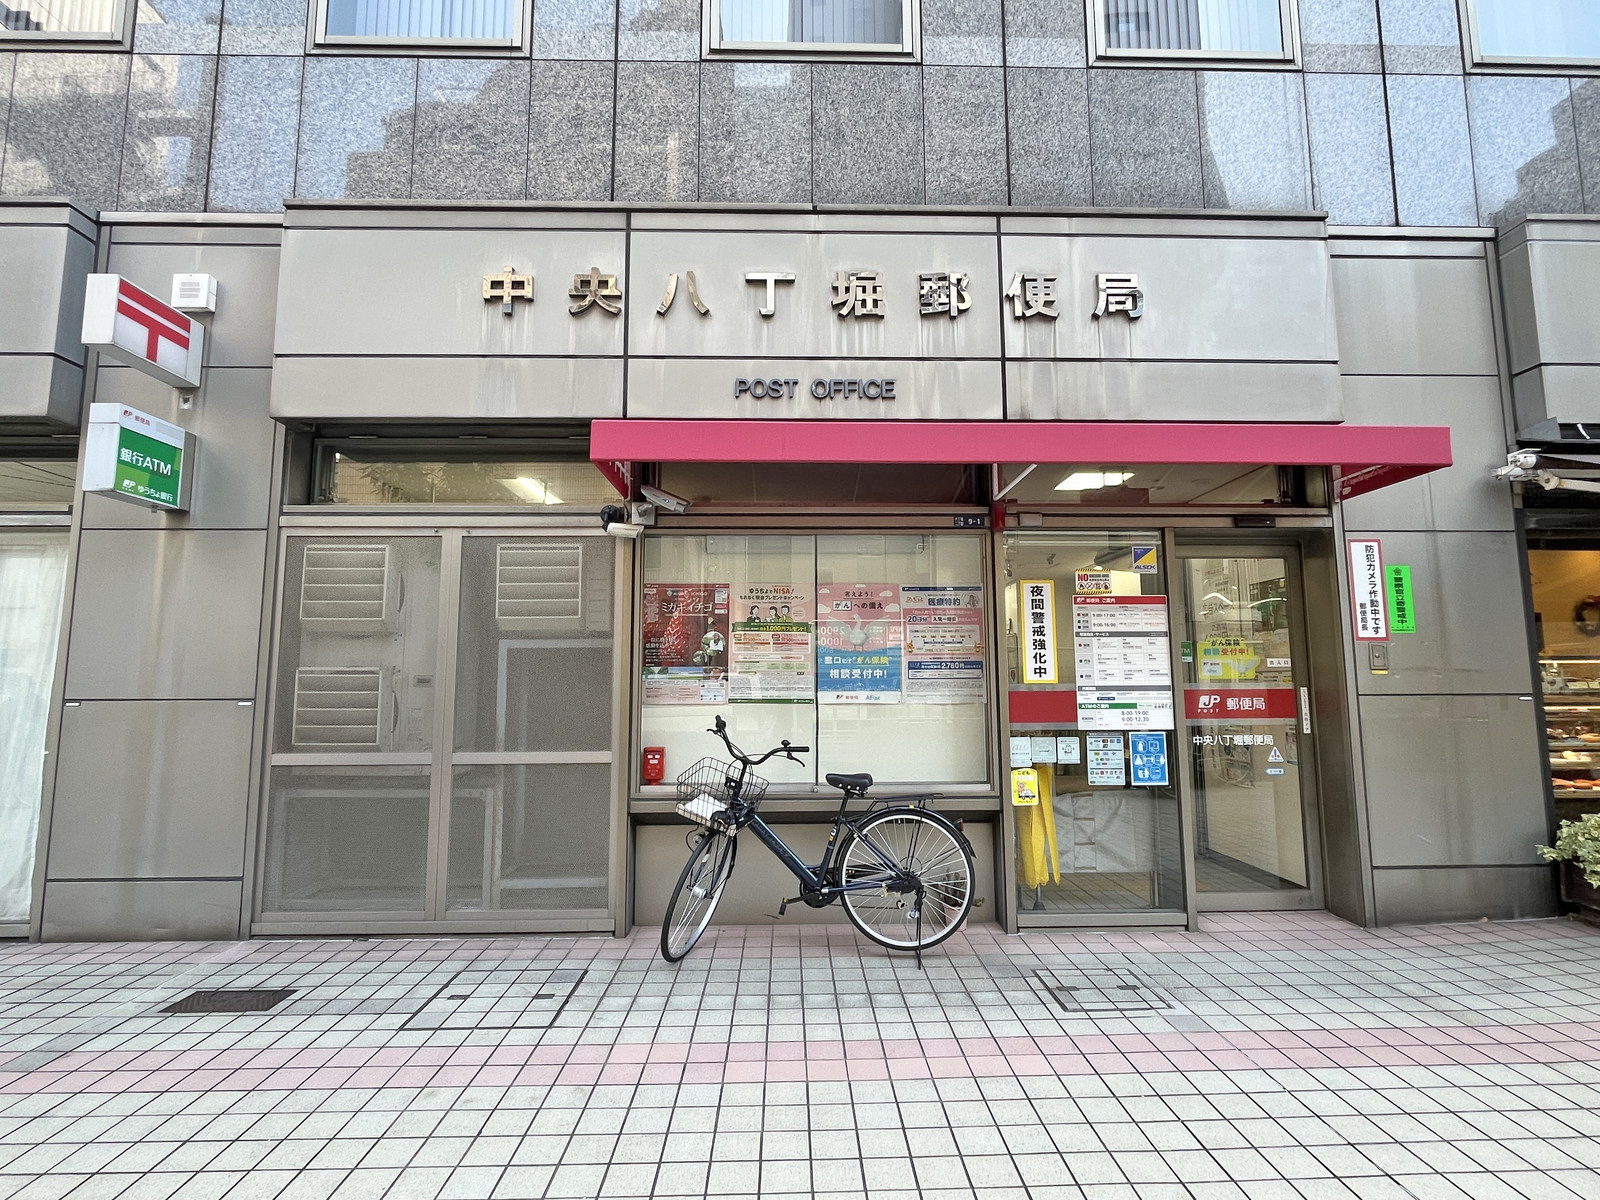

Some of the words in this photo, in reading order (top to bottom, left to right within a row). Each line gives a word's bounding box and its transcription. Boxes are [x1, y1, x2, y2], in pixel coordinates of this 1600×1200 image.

[482, 266, 1144, 319] 中央八丁堀郵便局
[735, 378, 798, 399] POST
[811, 378, 896, 400] OFFICE
[120, 447, 172, 476] 銀行ATM
[137, 485, 174, 502] ゆうちょ銀行
[1364, 544, 1382, 635] 防犯カメラ作動中です
[829, 668, 887, 679] 相談受付中!
[1199, 695, 1221, 709] JP
[1226, 697, 1266, 711] 郵便局
[1193, 734, 1274, 746] 中央八丁堀郵便局
